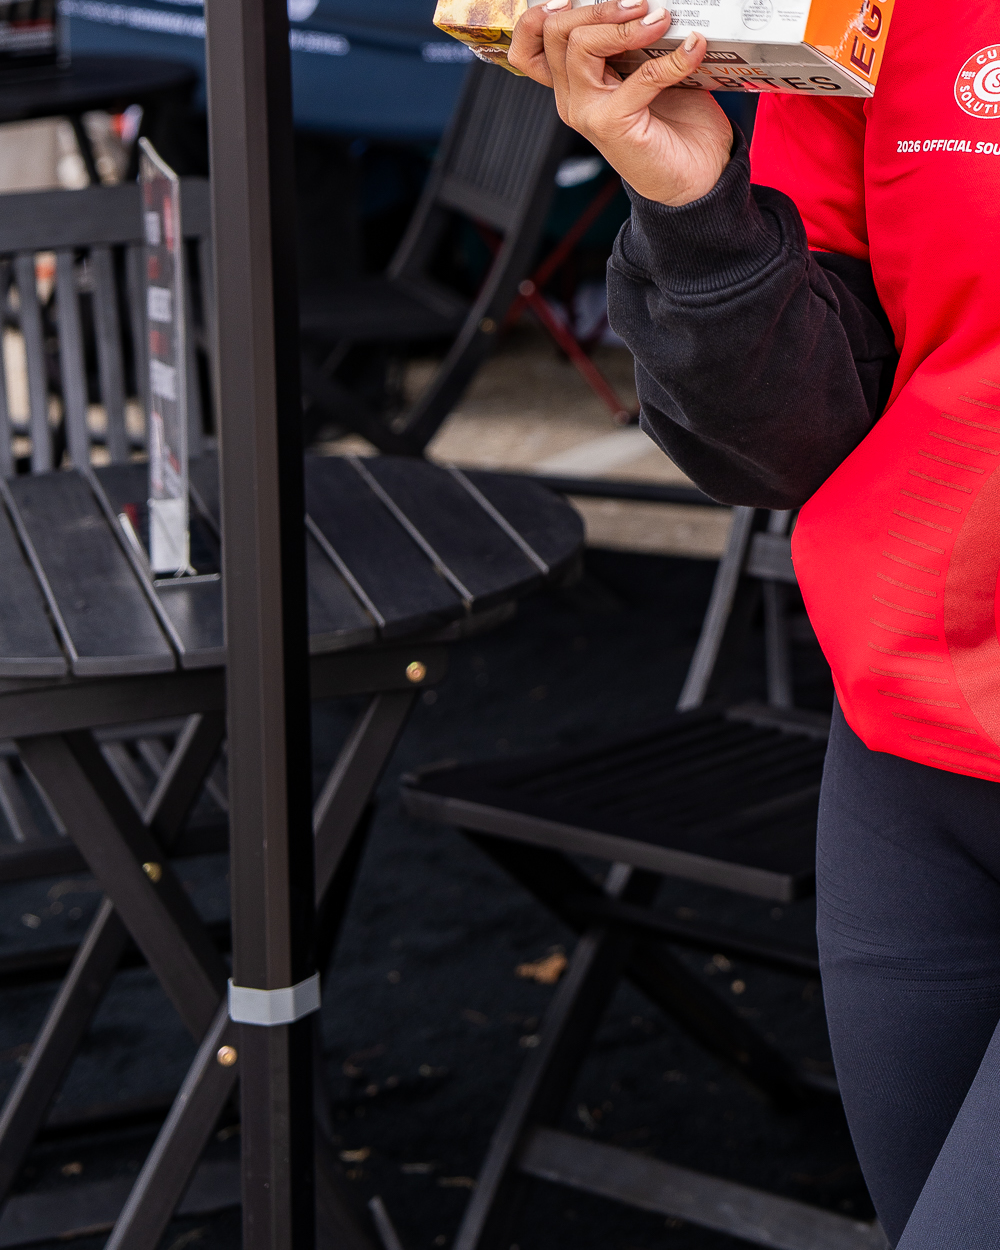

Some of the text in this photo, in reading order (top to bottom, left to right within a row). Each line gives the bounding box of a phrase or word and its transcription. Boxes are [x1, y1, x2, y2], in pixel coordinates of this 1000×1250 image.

[714, 67, 768, 76] VIDE
[710, 75, 842, 91] BITES
[897, 140, 921, 153] 2026
[923, 139, 972, 153] OFFICIAL
